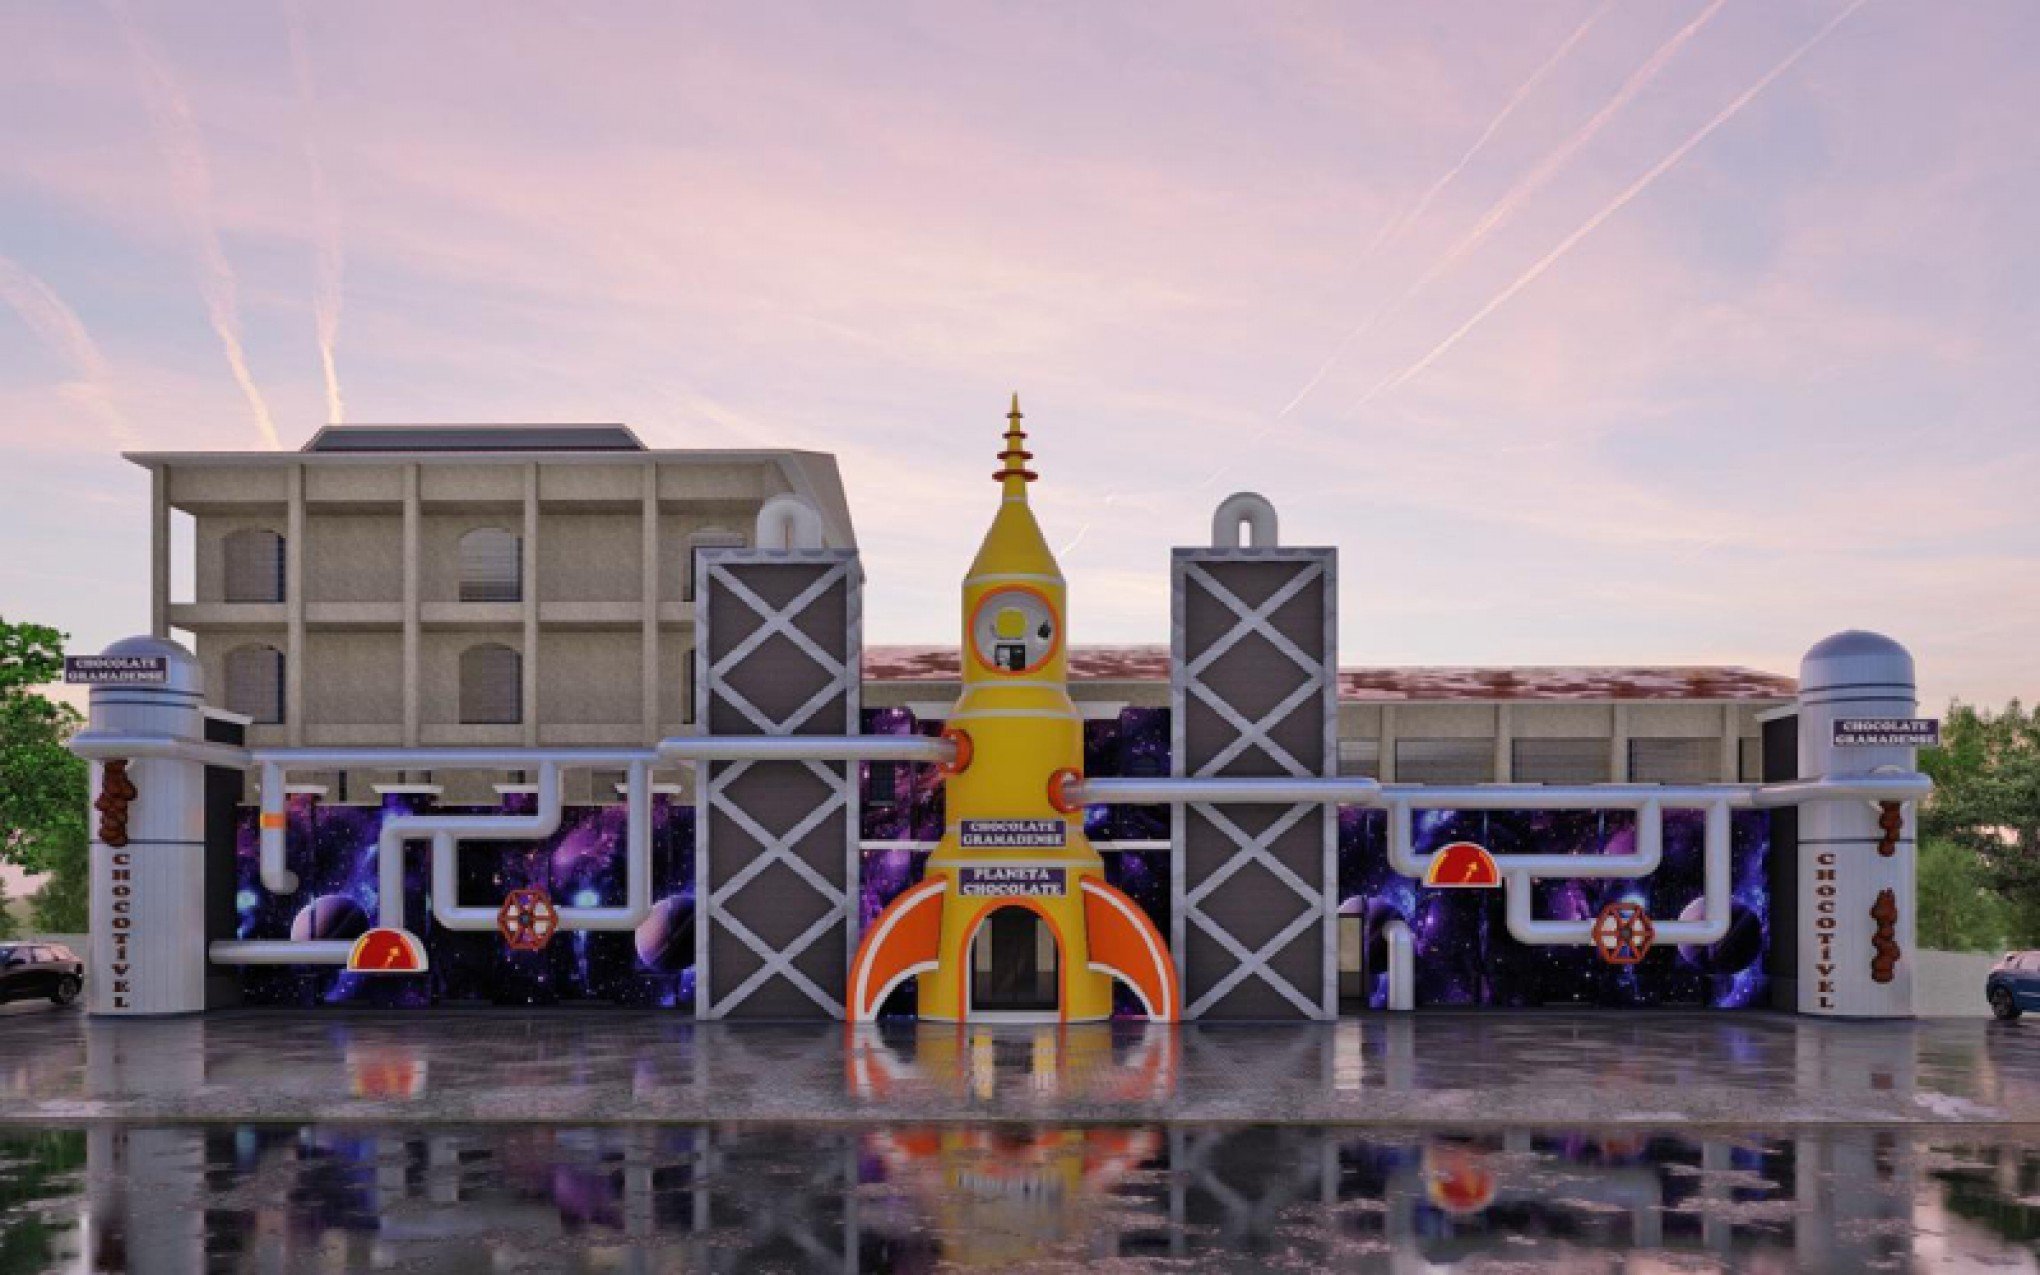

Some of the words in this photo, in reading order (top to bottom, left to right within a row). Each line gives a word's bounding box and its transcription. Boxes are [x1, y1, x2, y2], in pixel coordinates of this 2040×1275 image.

[74, 658, 156, 669] CHOCOLATE
[1843, 721, 1928, 732] CHOCOLATE
[970, 821, 1056, 832] CHOCOLATE
[973, 869, 1049, 880] PLANETA
[963, 884, 1062, 895] CHOCOLATE
